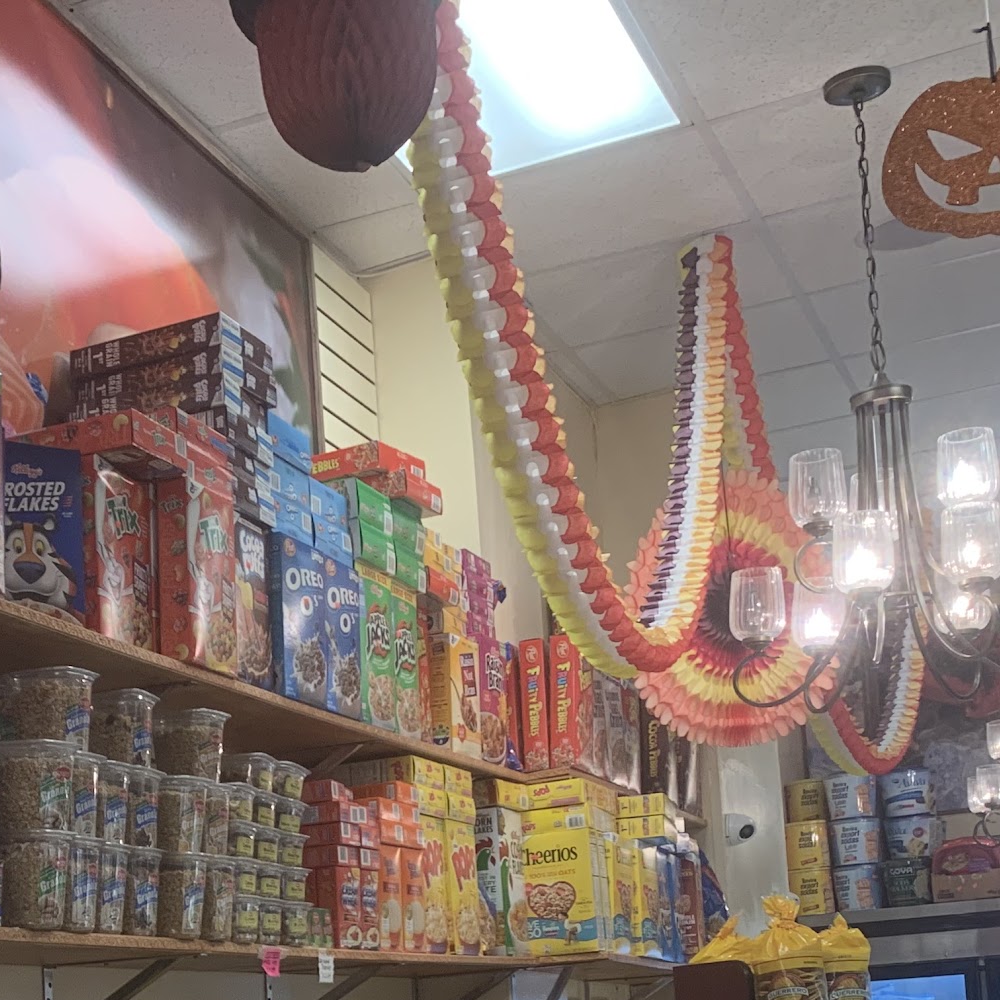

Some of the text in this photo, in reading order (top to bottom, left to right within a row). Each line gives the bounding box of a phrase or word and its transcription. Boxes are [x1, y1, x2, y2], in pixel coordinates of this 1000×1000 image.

[312, 459, 340, 475] EBBLES
[4, 481, 66, 497] ROSTED
[285, 567, 324, 591] OREO
[890, 867, 914, 876] GOYA
[768, 986, 809, 1000] GUERRERO
